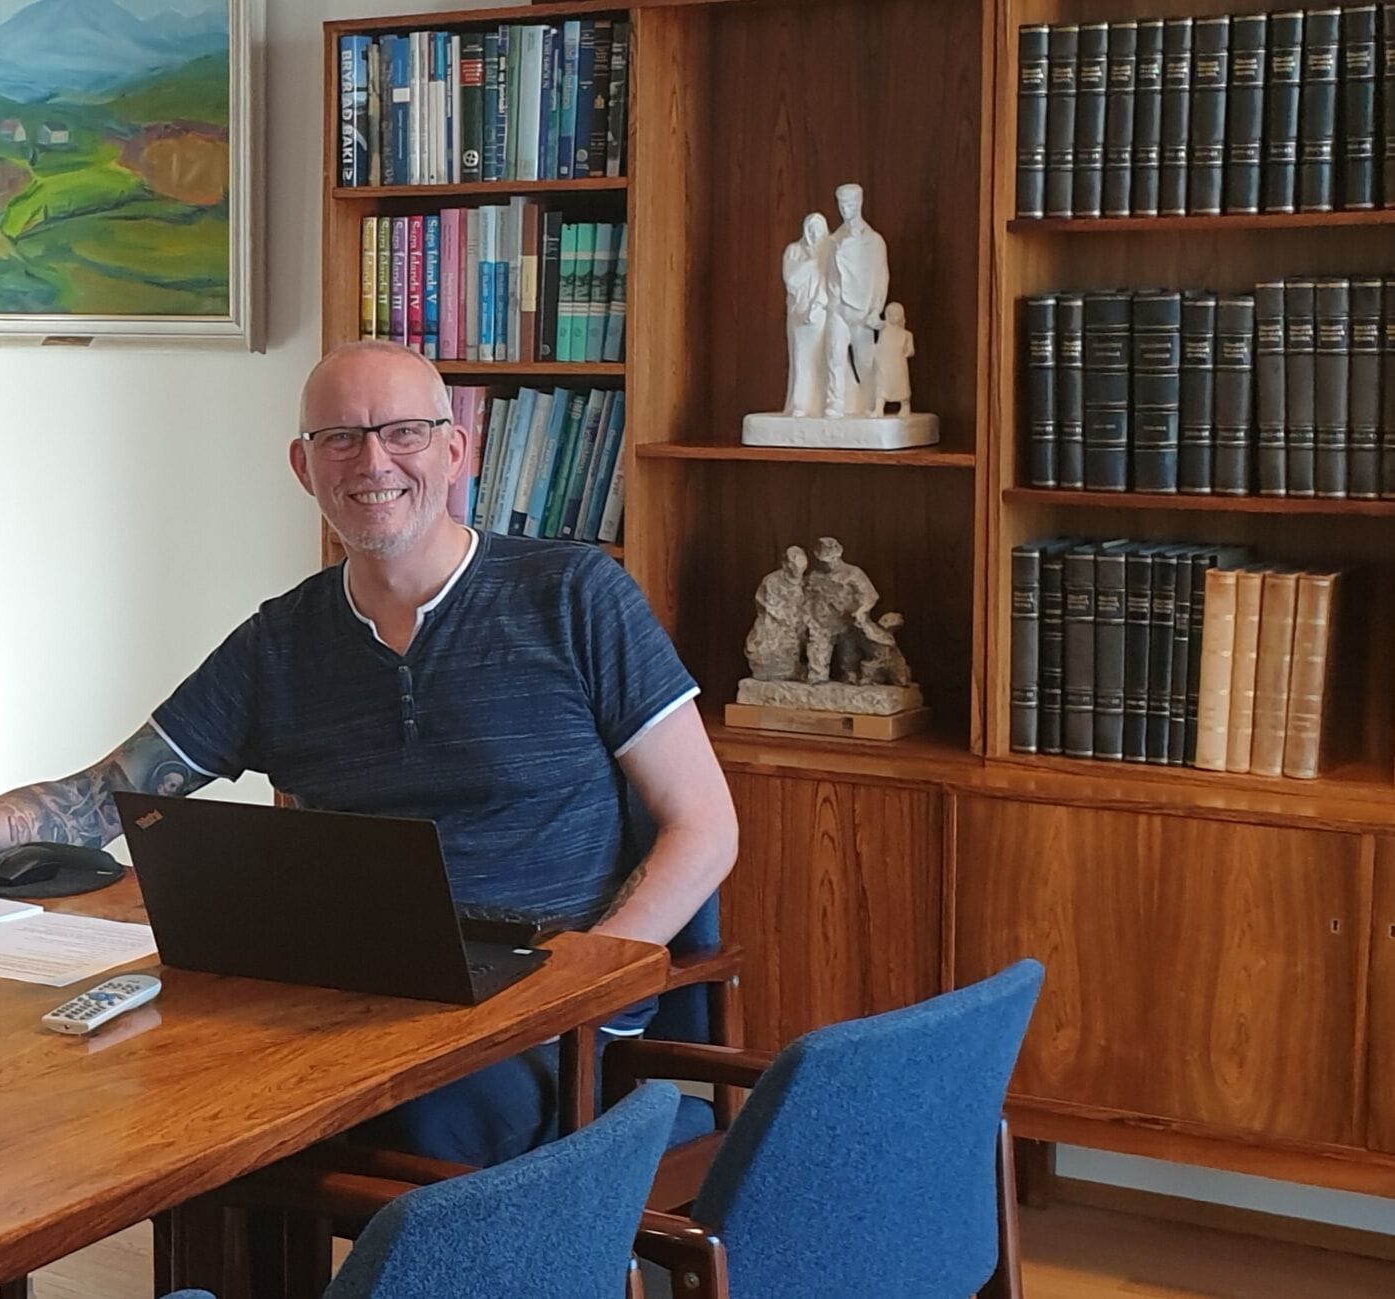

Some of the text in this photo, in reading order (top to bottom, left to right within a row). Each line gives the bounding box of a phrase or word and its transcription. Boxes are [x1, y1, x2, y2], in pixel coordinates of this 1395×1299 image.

[342, 124, 353, 163] BAKI
[393, 295, 402, 310] III
[410, 294, 420, 309] IV
[427, 293, 438, 304] V
